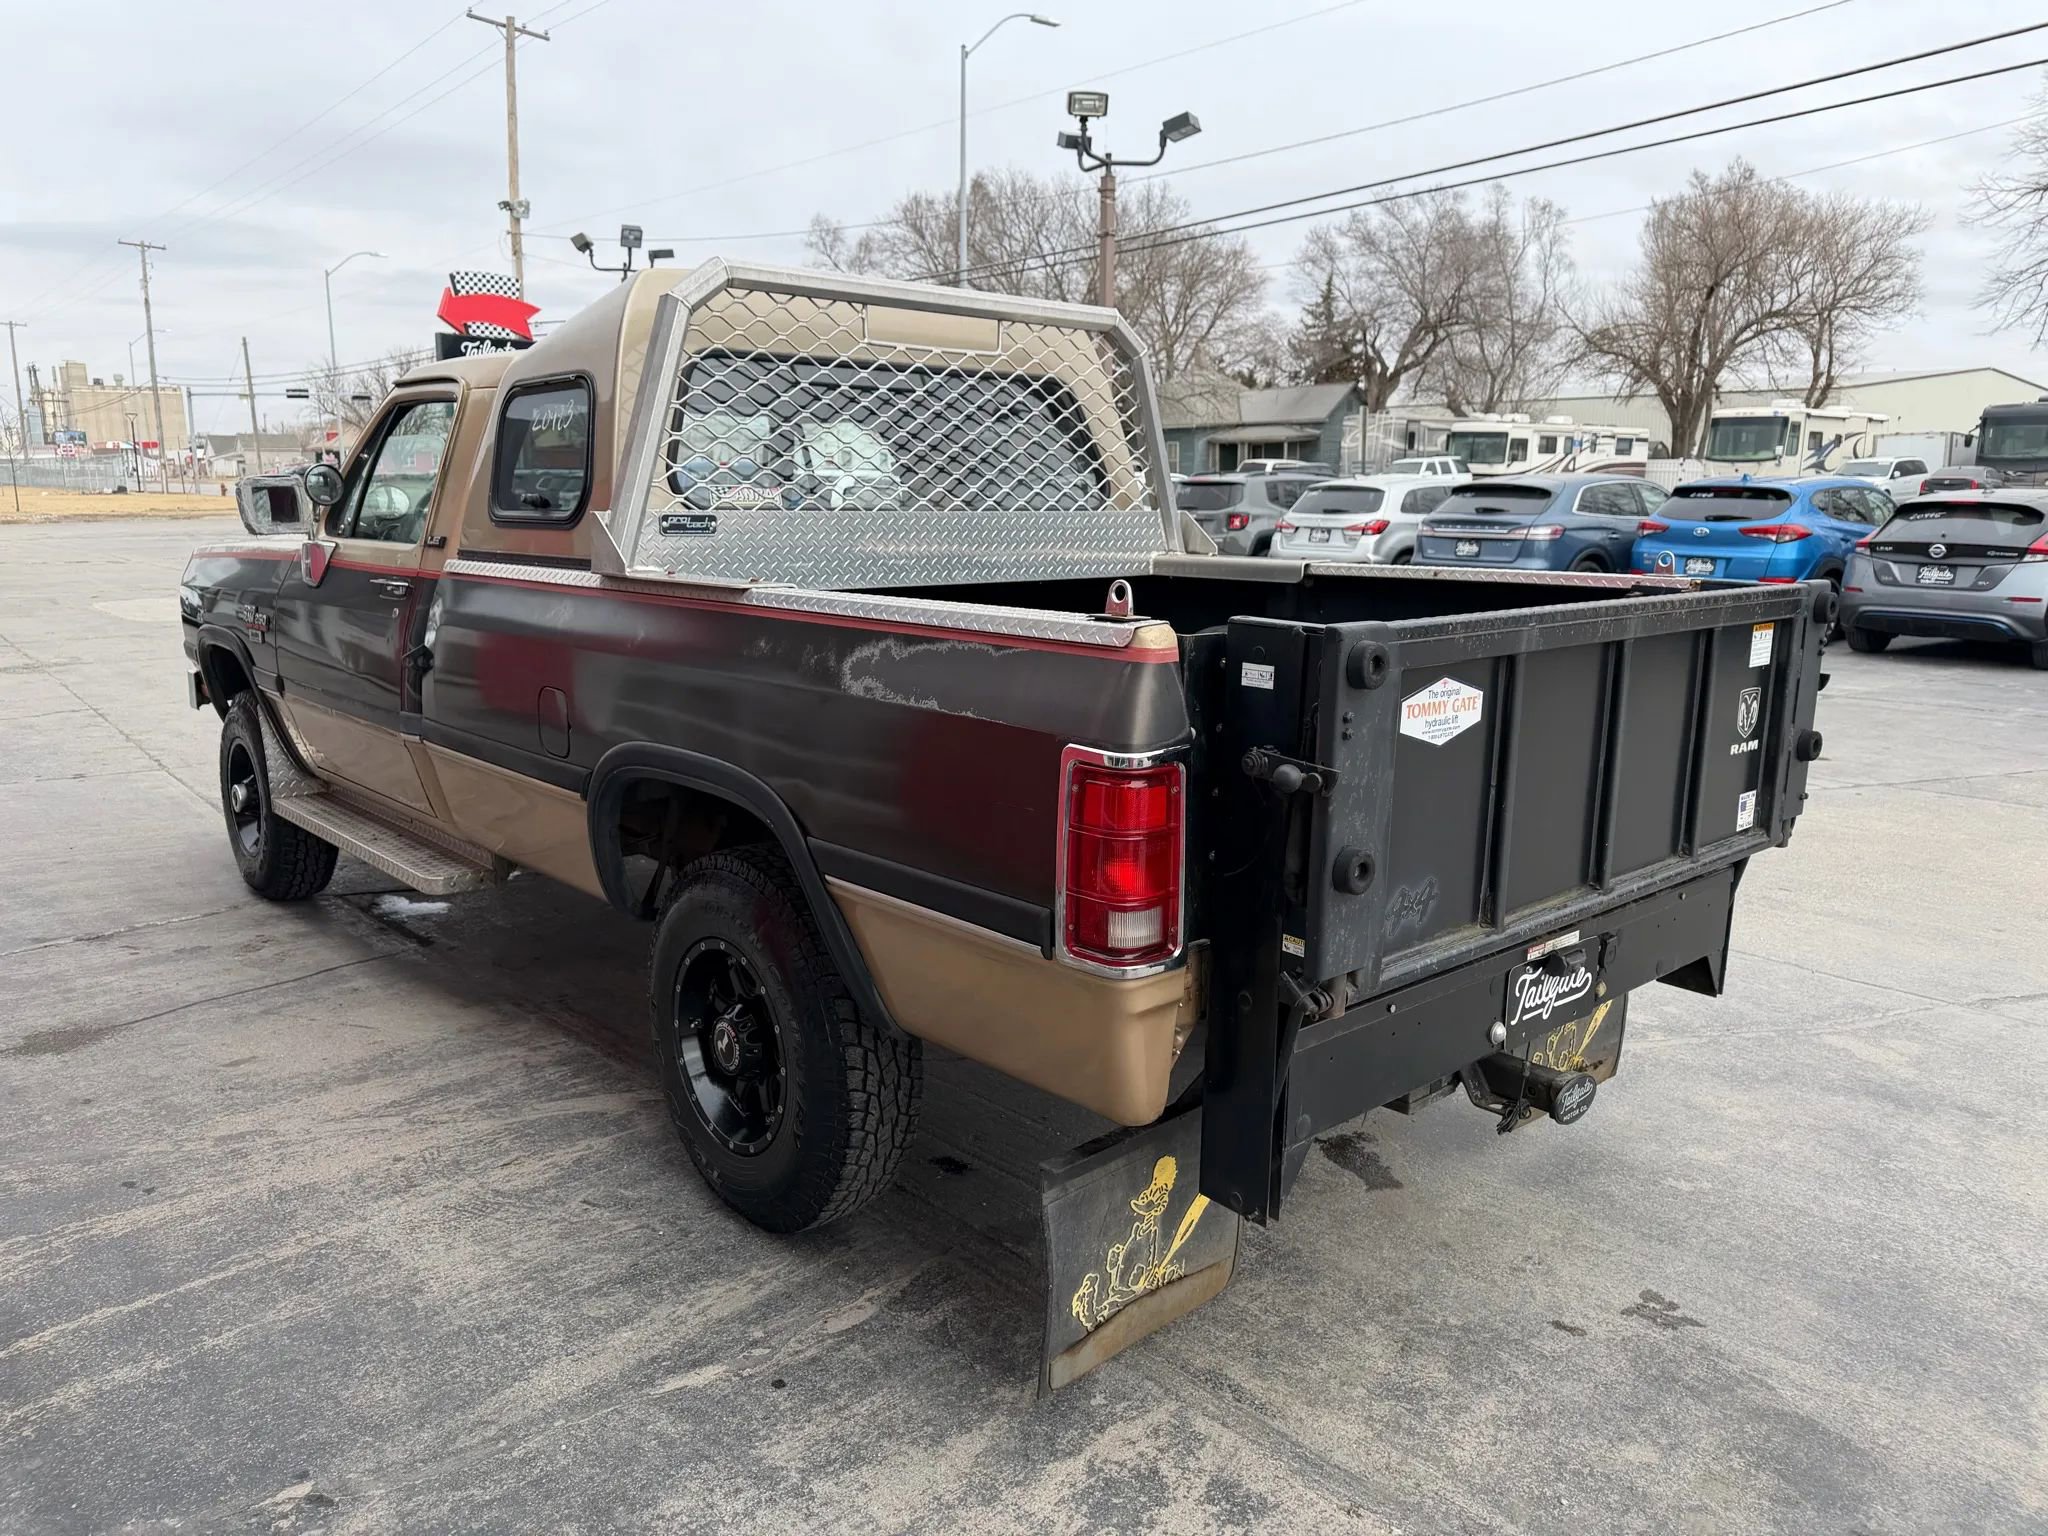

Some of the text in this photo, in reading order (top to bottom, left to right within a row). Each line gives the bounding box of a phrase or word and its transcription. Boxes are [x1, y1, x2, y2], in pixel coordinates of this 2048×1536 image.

[461, 340, 518, 357] Tailt
[1428, 686, 1462, 700] The original
[1406, 696, 1478, 720] TOMMY GATE
[1424, 715, 1459, 730] hydraulic lift
[1730, 739, 1759, 755] RAM
[1560, 1078, 1594, 1115] Tailgate
